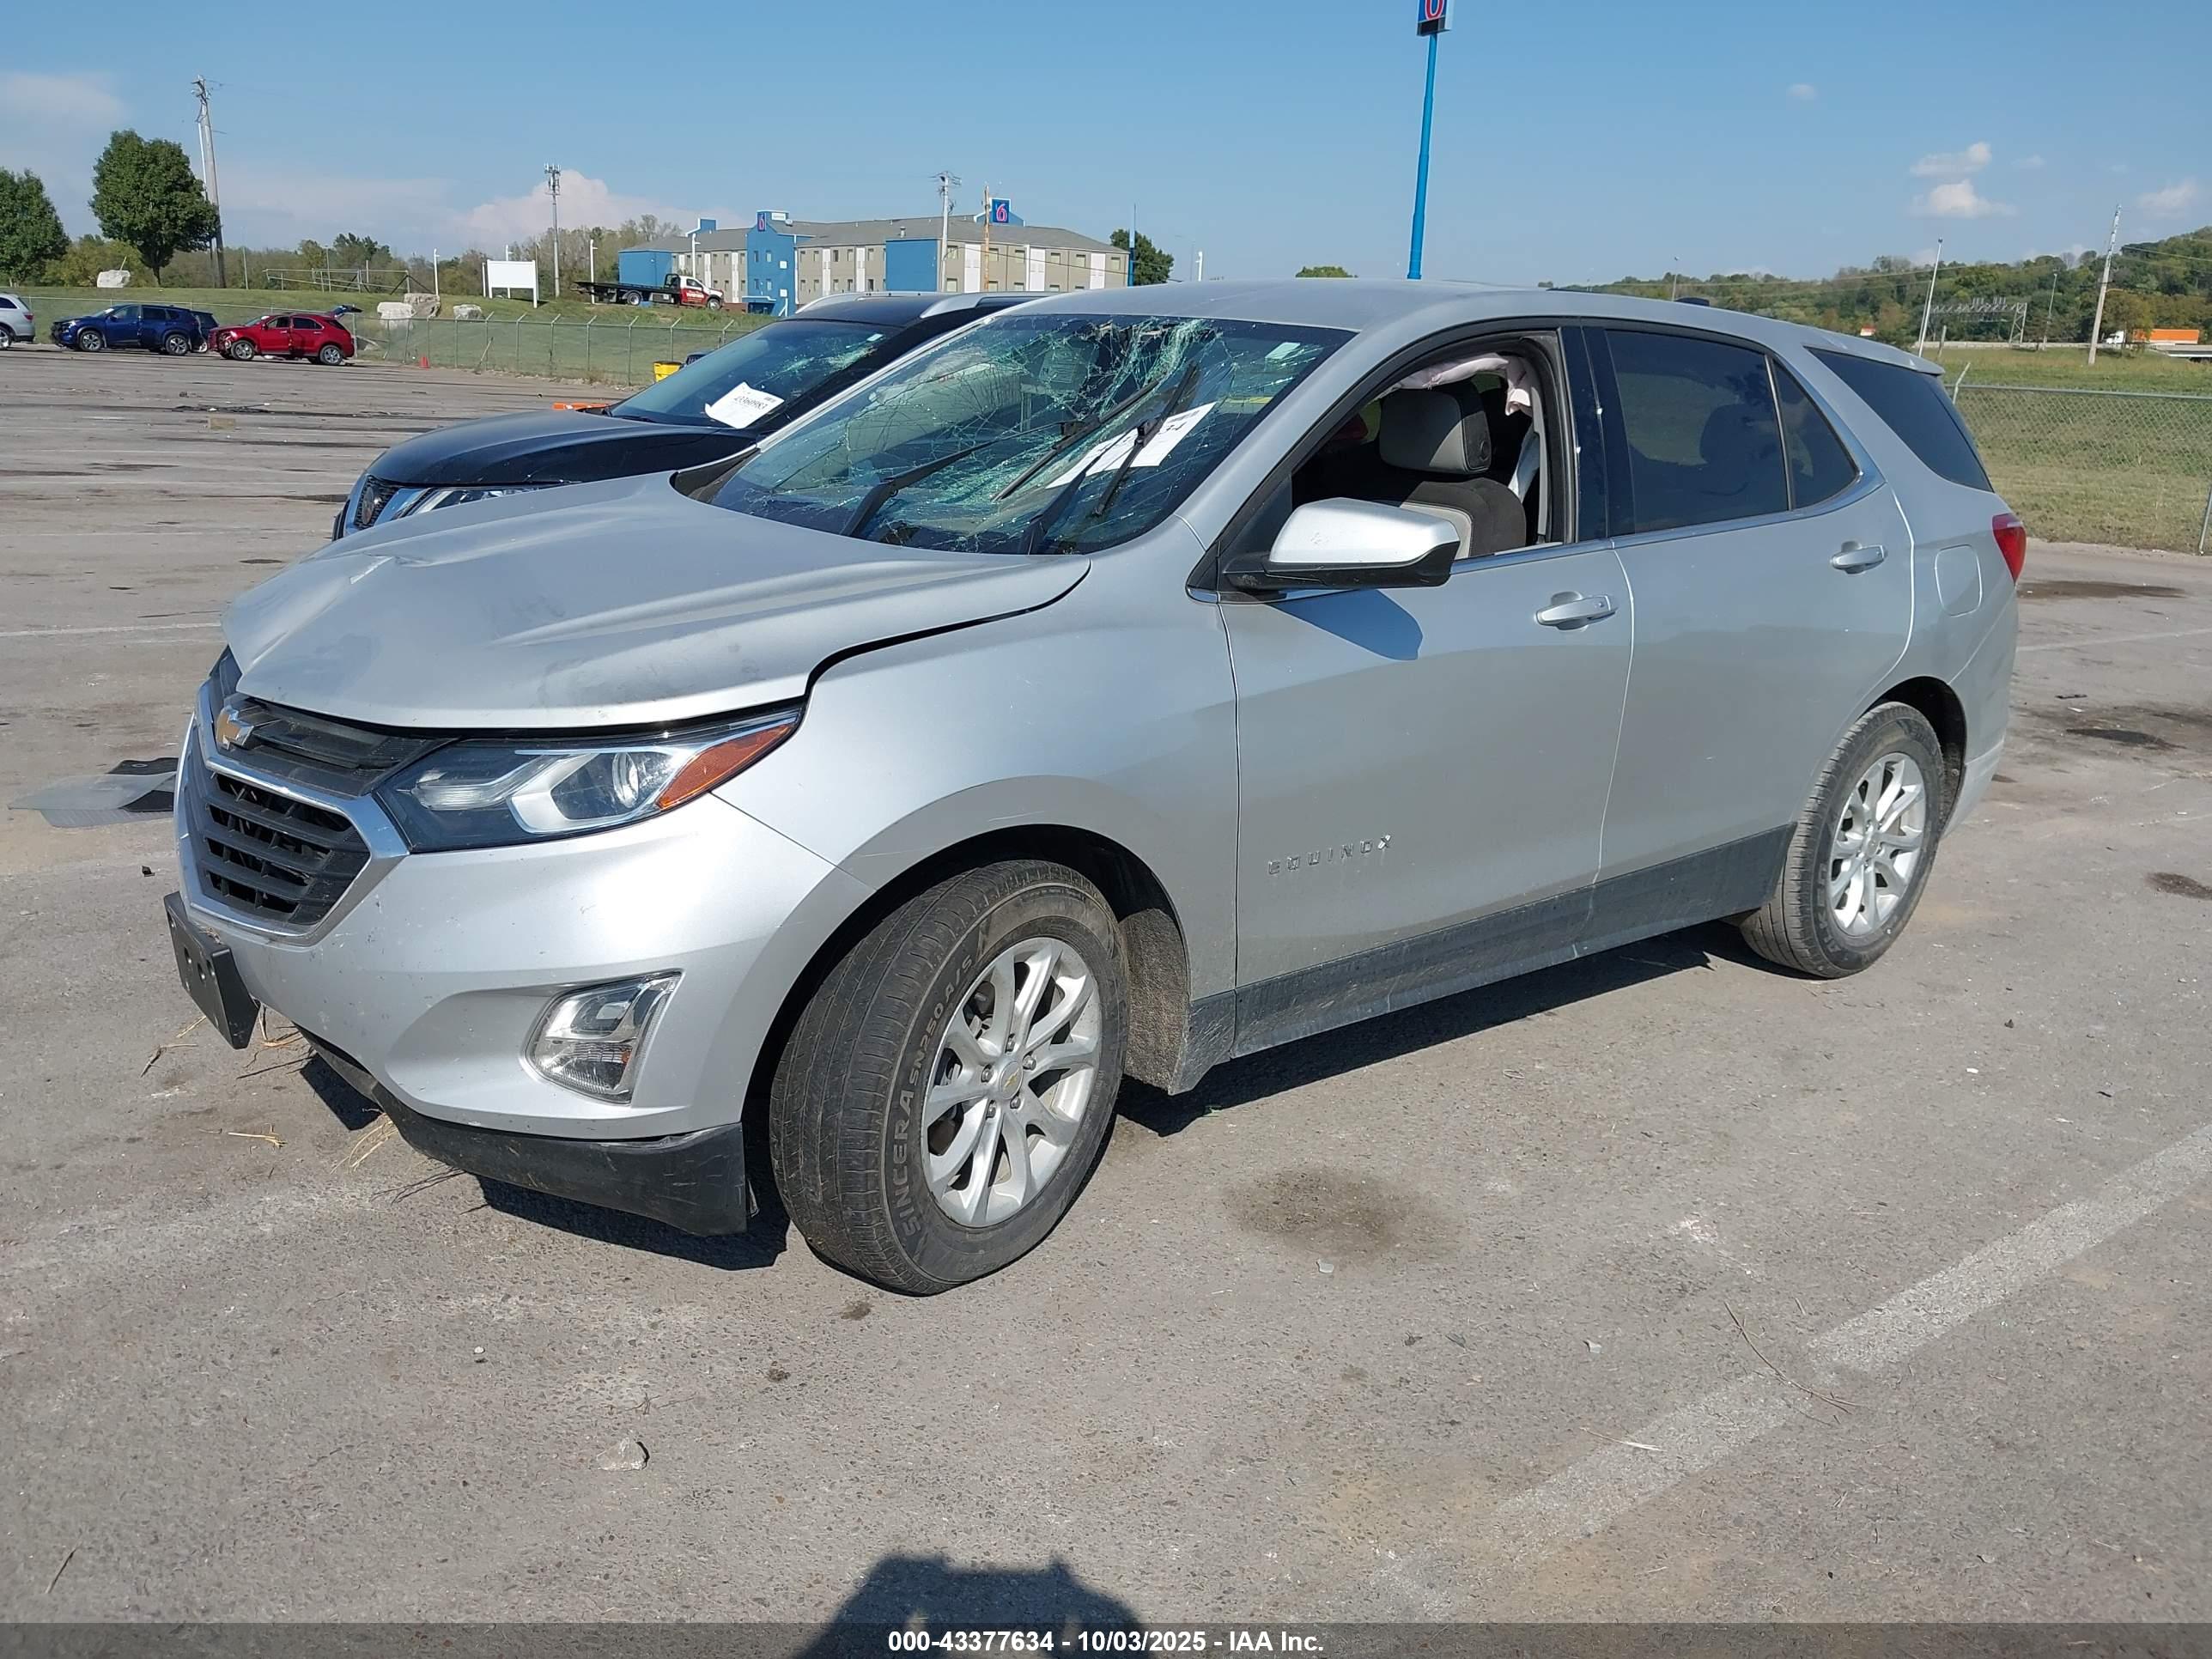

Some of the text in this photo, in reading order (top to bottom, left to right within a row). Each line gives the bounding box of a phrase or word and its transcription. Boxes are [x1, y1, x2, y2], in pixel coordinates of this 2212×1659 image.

[996, 203, 1008, 222] 6
[1267, 834, 1392, 875] EQUINOX
[892, 954, 972, 1237] SINCERA SN250 A/S
